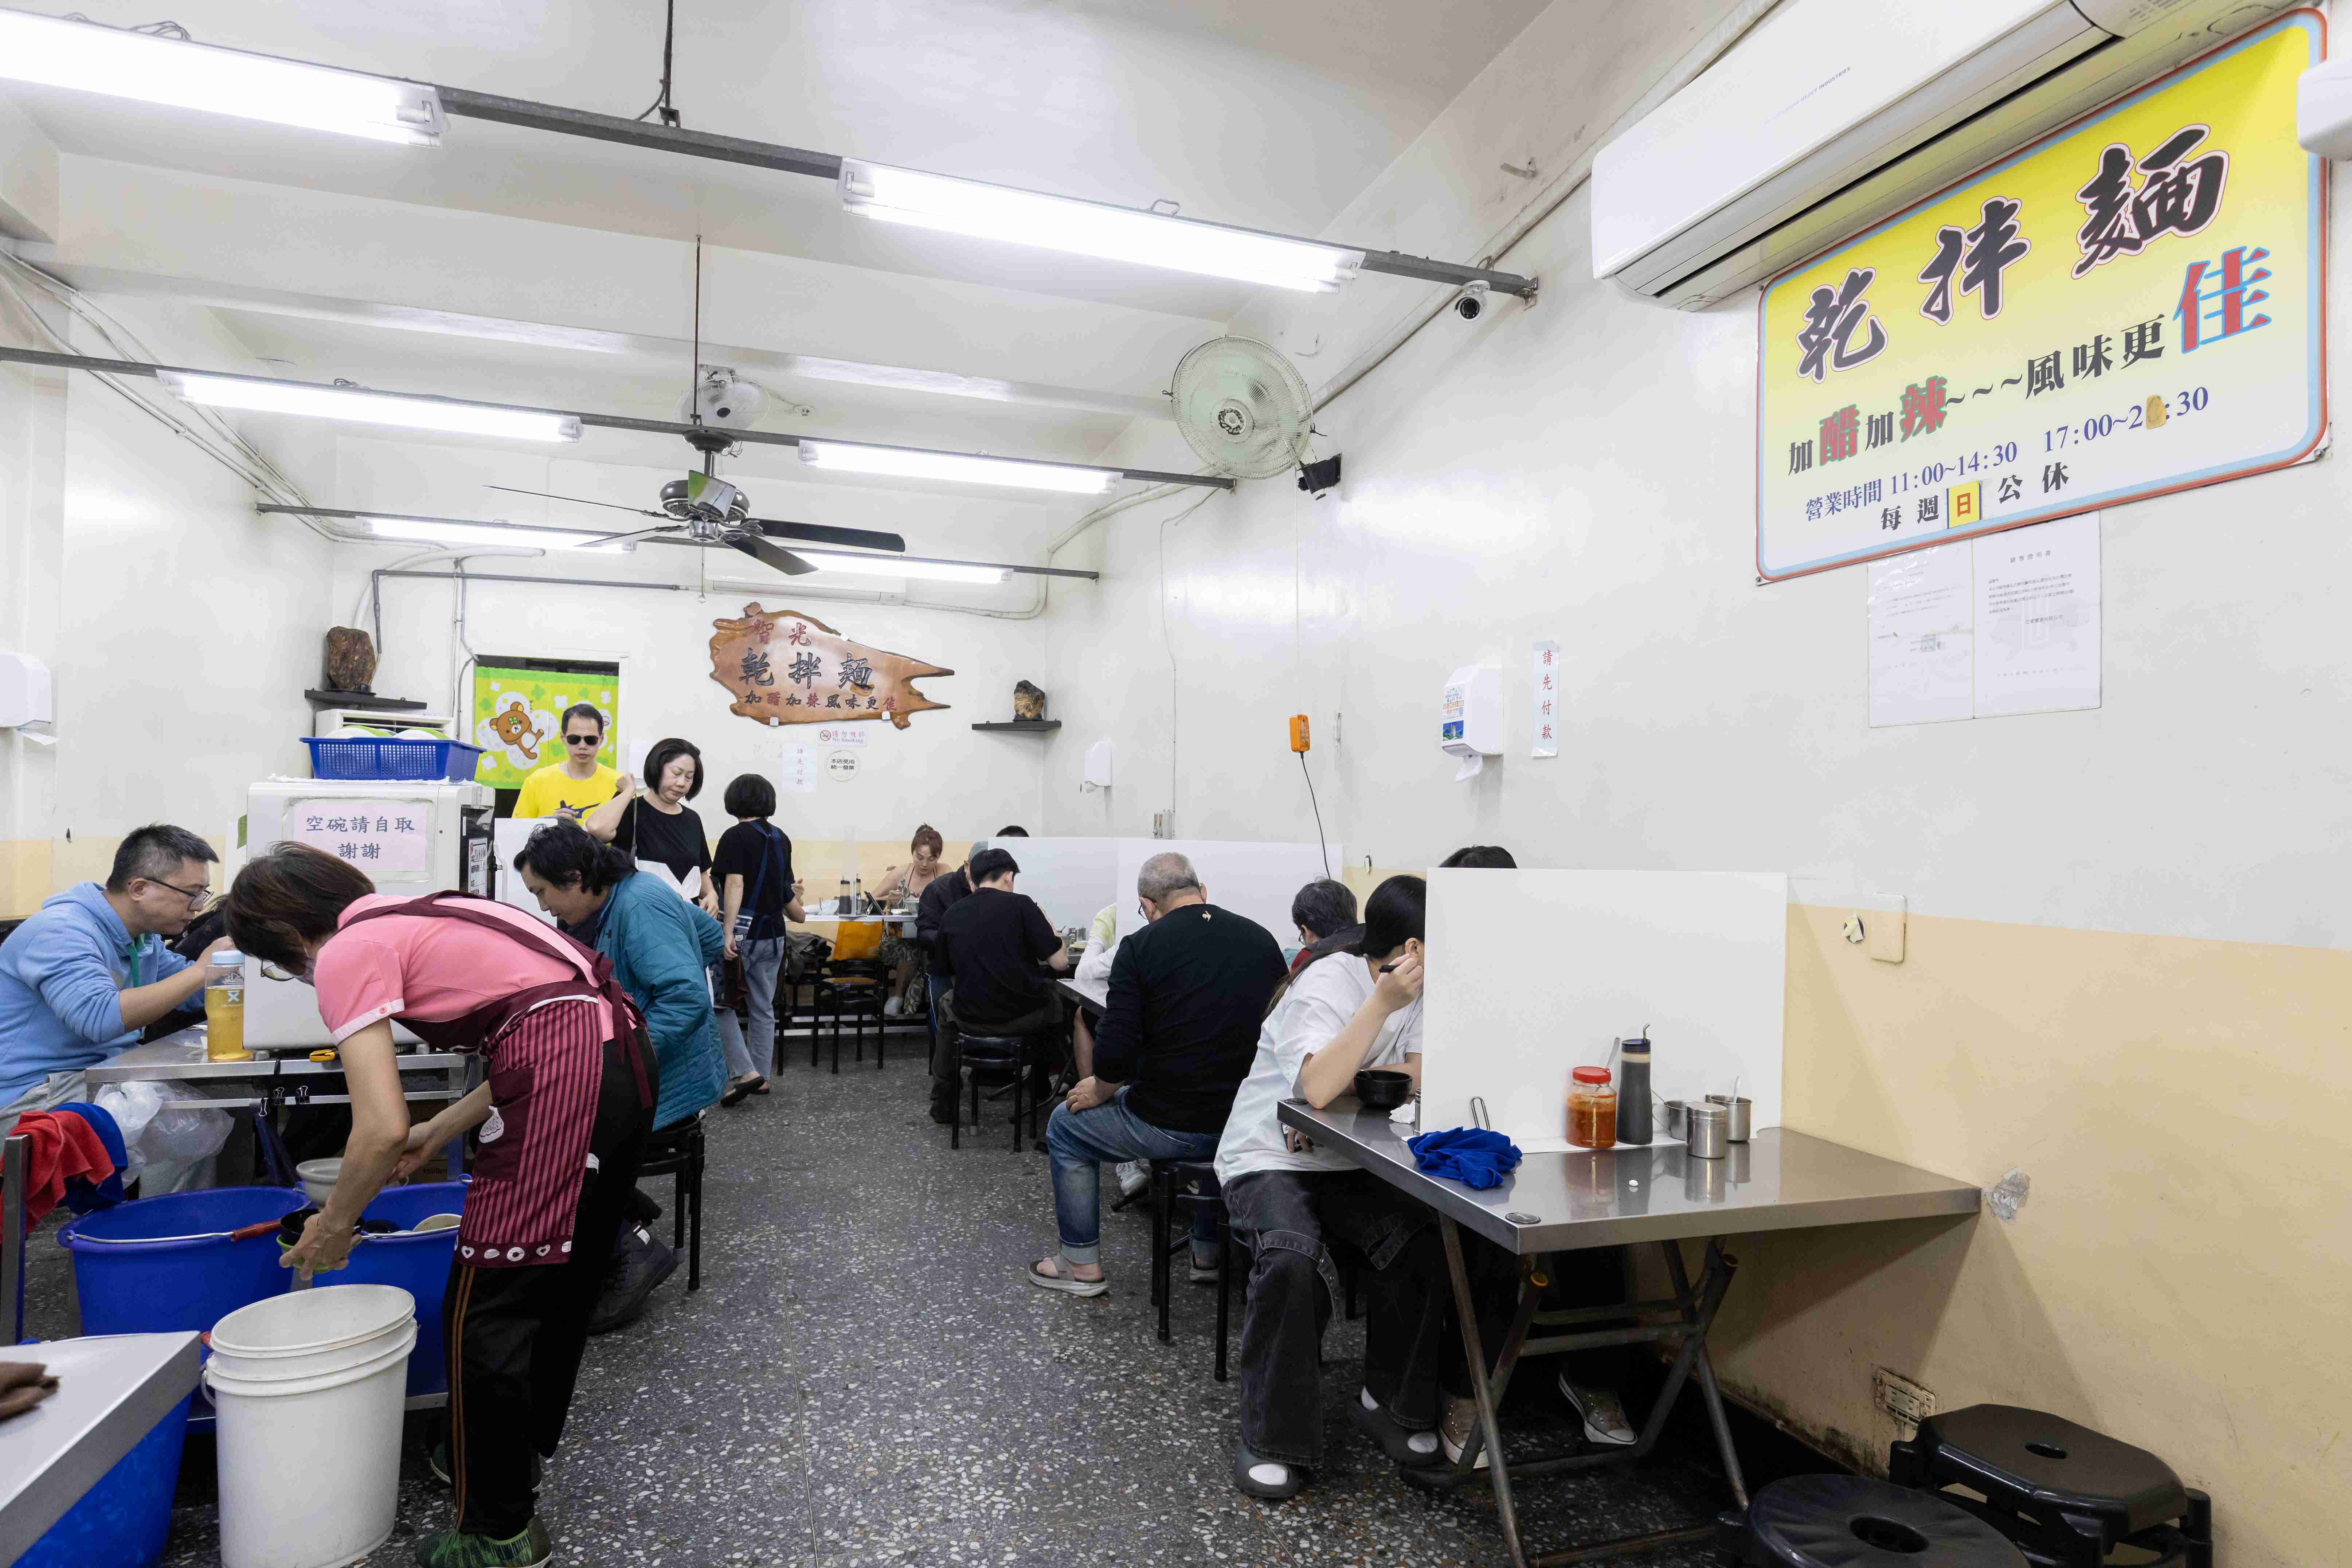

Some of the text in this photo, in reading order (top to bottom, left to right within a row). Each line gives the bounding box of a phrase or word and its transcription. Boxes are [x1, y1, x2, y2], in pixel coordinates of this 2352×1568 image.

[1819, 66, 1851, 91] INDUSTRIES
[1797, 125, 2229, 382] 乾拌麵
[1806, 479, 1881, 521] 營業時間
[1891, 442, 2017, 495] 11:00~14:30
[1881, 465, 2070, 531] 每週日公休
[753, 619, 811, 646] 智光
[739, 648, 874, 690] 乾拌麵
[745, 690, 897, 711] 加醋加辣風味更佳
[1541, 649, 1553, 740] 請先付款
[306, 816, 415, 833] 空碗請自取
[338, 842, 381, 860] 謝謝
